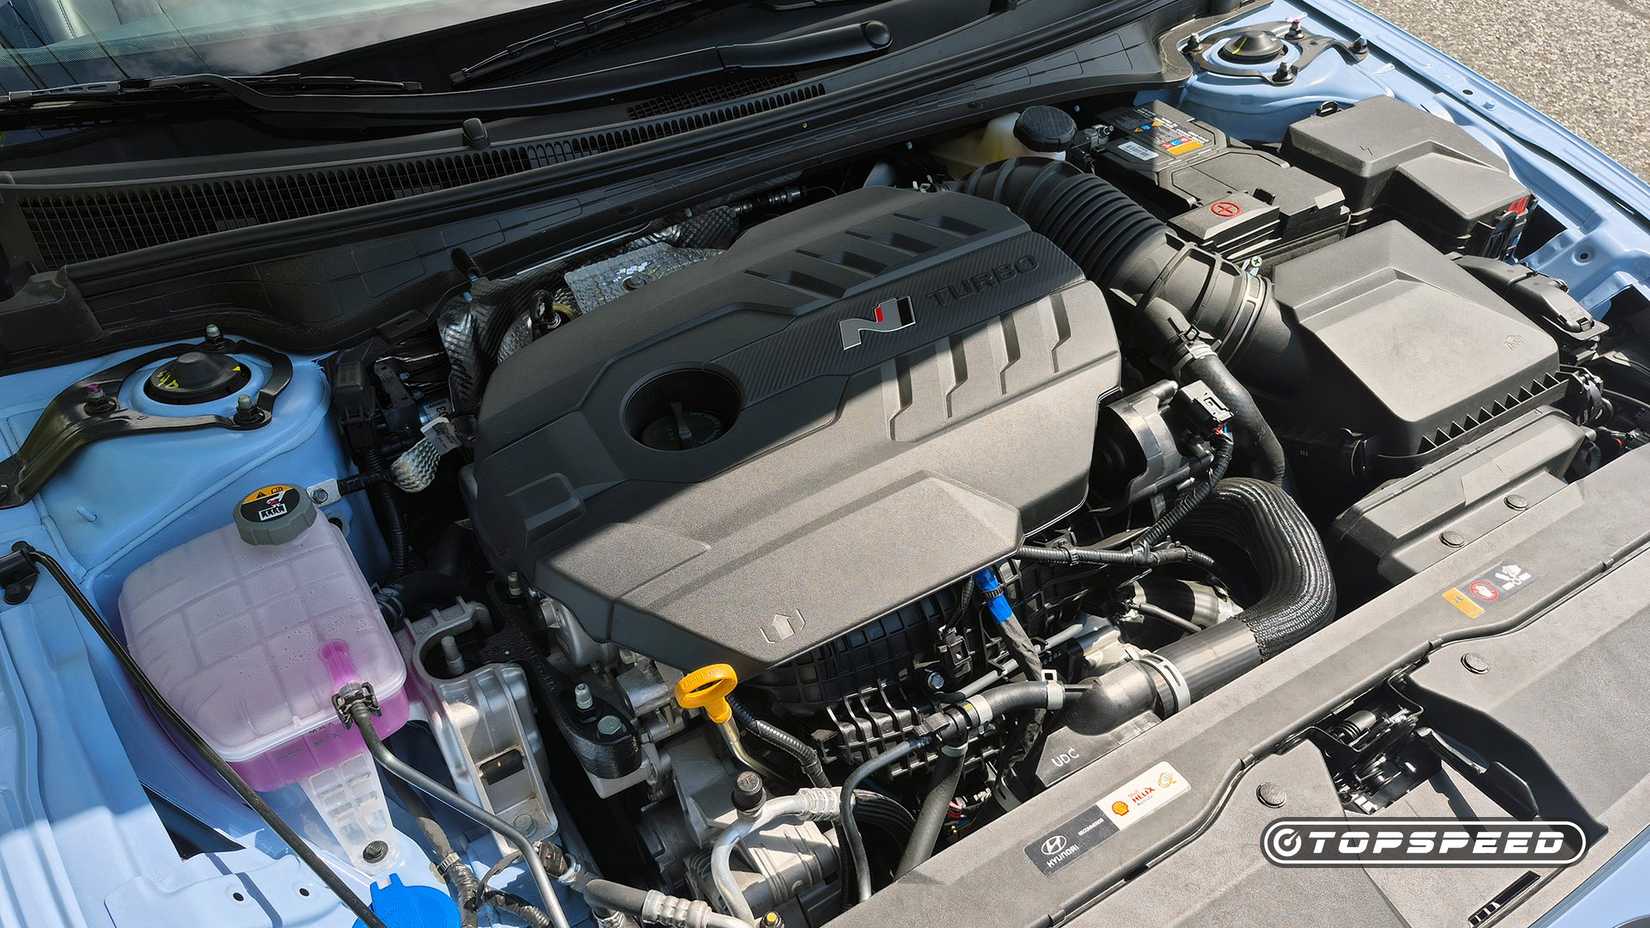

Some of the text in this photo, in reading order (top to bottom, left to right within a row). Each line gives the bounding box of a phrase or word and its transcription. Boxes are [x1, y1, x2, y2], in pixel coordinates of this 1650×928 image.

[927, 254, 1040, 307] TURBO
[1051, 747, 1080, 767] UDC
[1046, 843, 1080, 868] HYUNDAI
